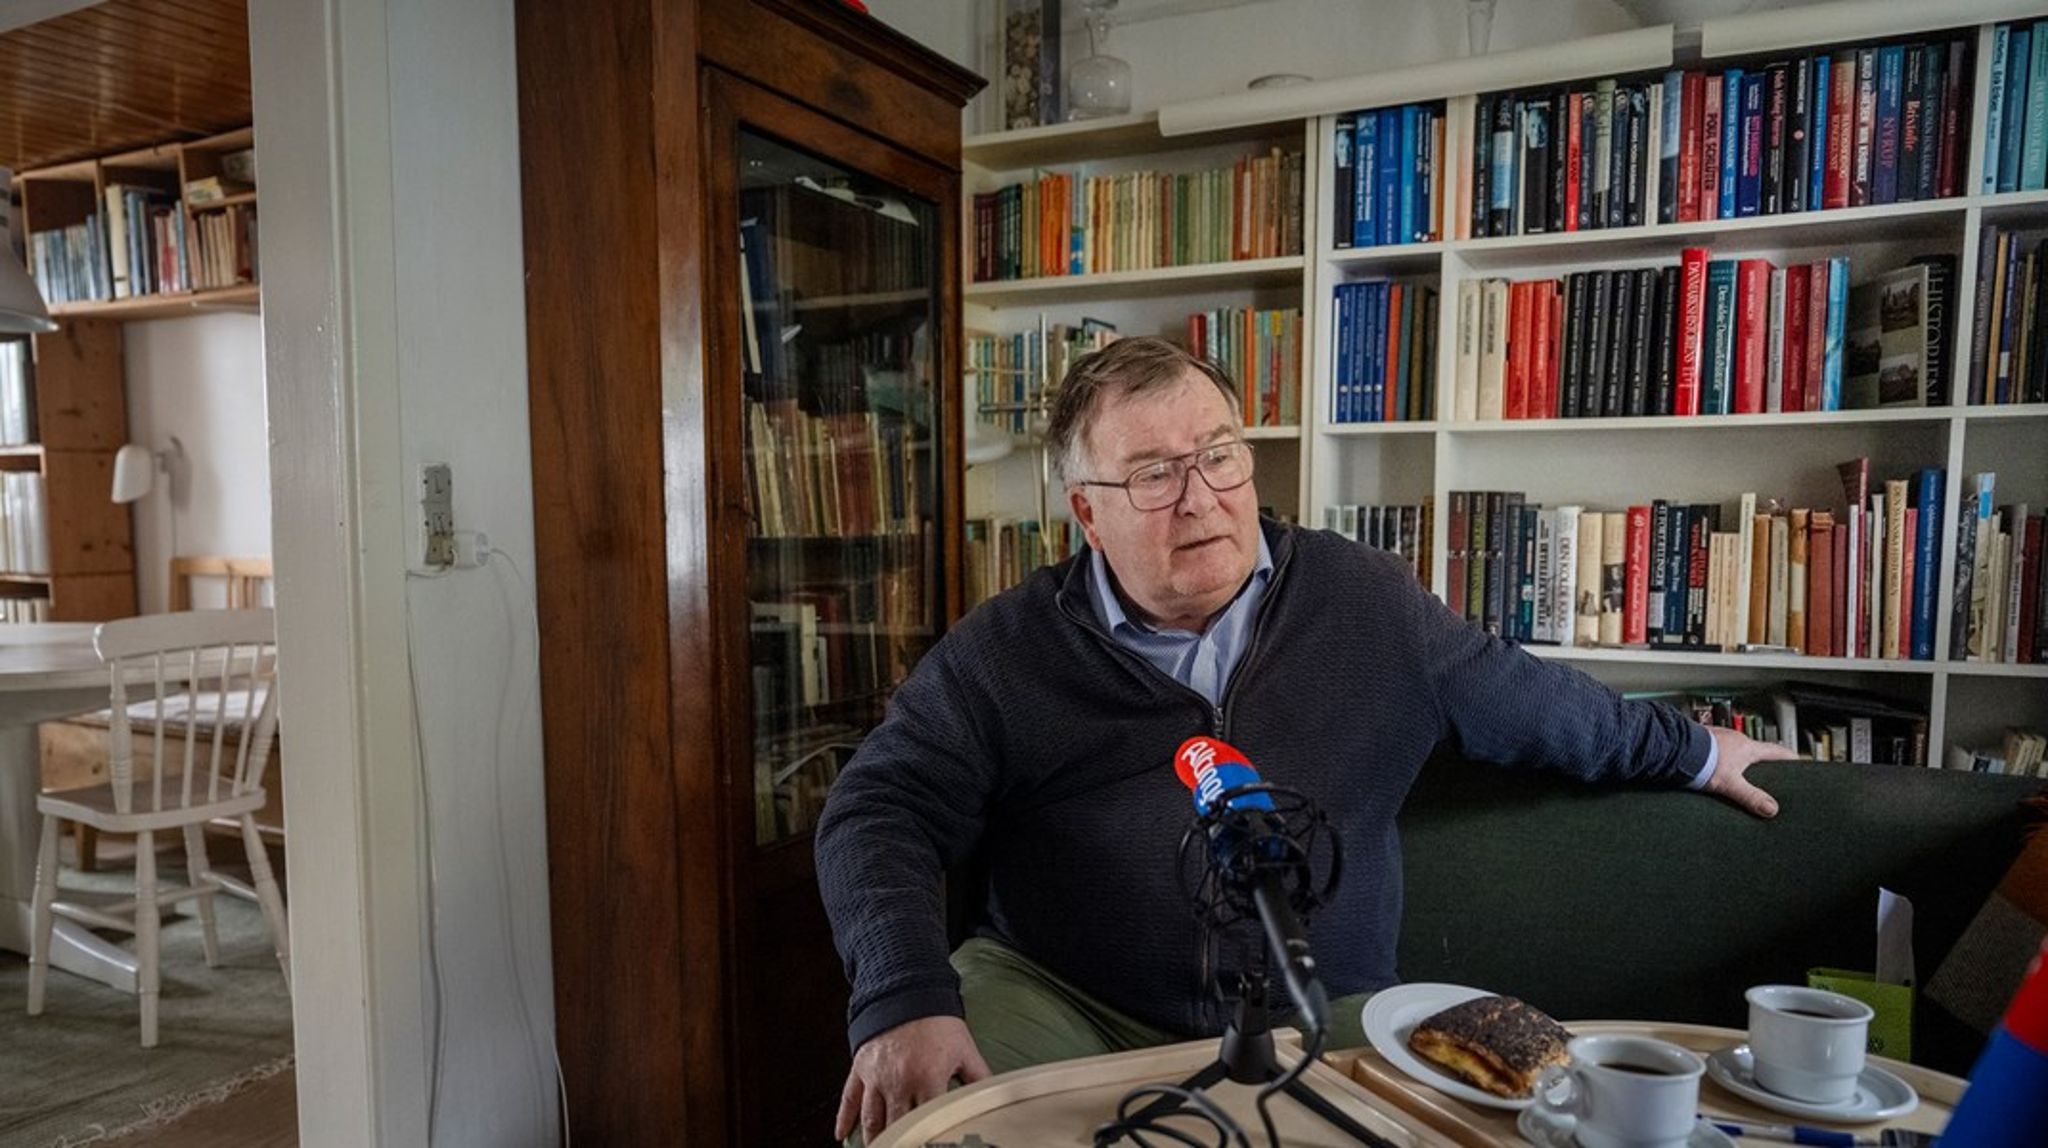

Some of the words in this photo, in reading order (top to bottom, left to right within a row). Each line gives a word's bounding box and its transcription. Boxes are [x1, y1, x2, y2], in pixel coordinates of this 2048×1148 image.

[1706, 112, 1718, 139] POUL
[1880, 116, 1895, 169] NYRUP
[1904, 101, 1920, 151] Brixtofte
[1704, 142, 1718, 192] SCHLÜTER
[1560, 537, 1570, 560] DEN
[1558, 562, 1569, 597] KOLDE
[1557, 600, 1568, 629] KRIG
[1181, 741, 1226, 807] Alting
